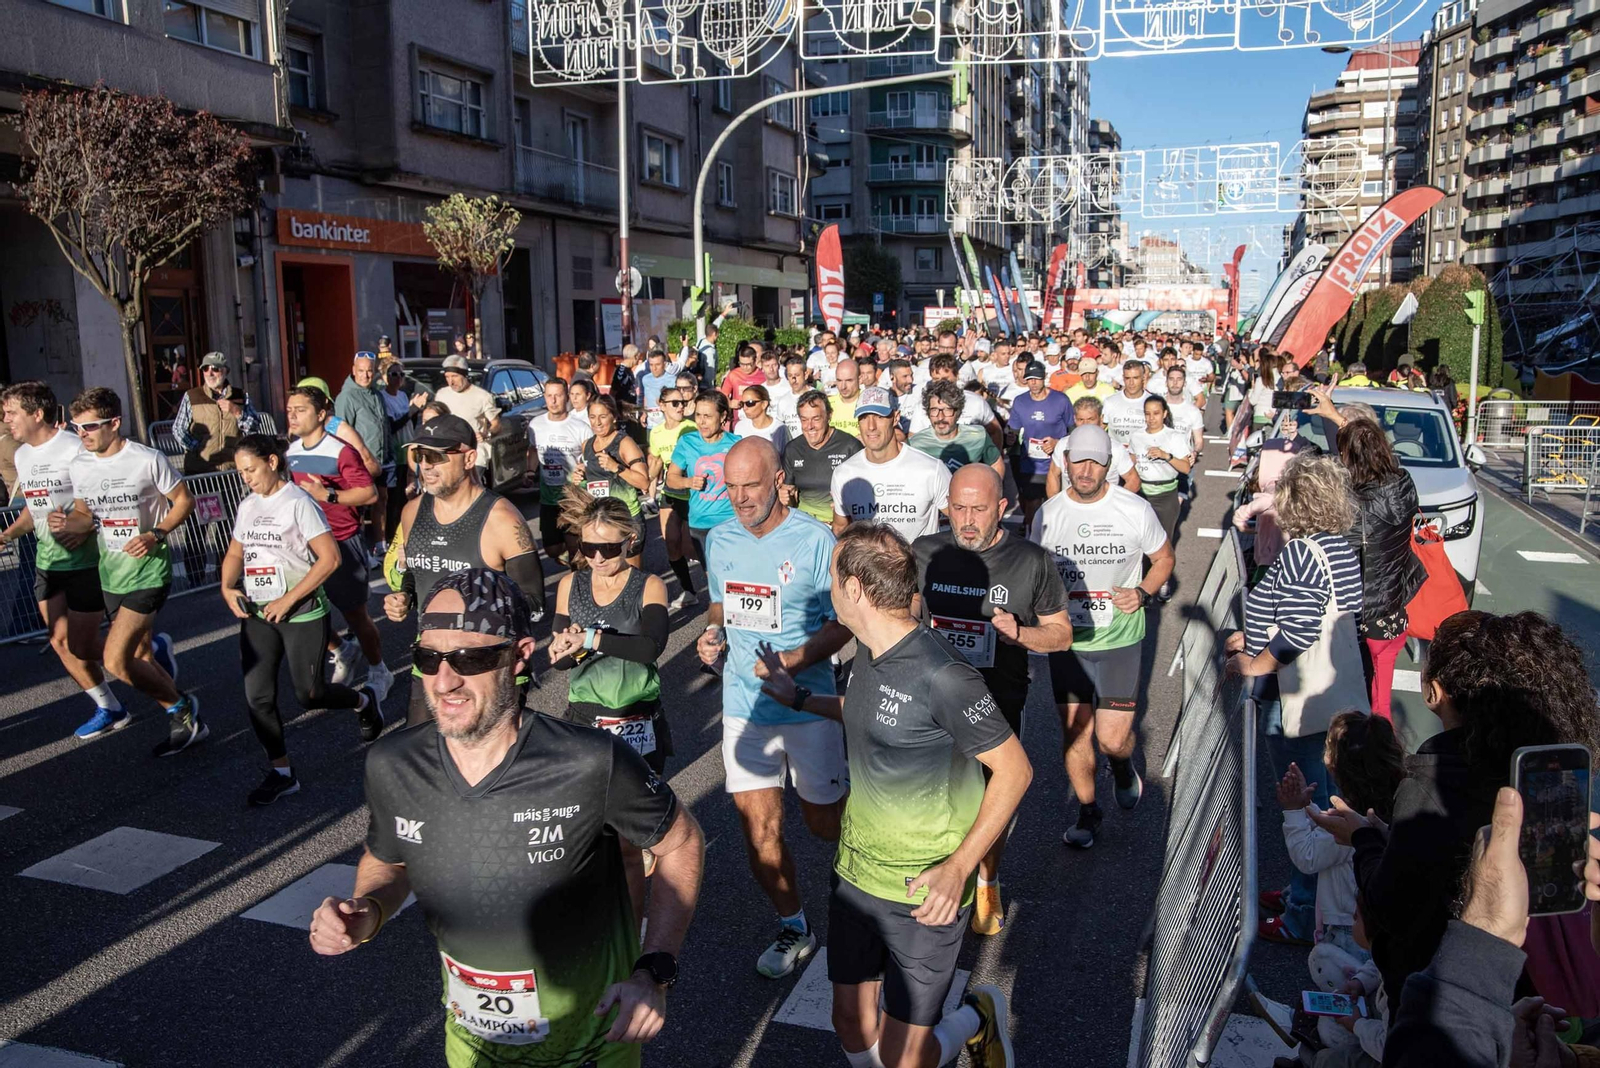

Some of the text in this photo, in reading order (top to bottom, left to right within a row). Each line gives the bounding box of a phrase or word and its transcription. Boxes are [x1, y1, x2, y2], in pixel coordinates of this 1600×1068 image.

[1330, 211, 1395, 287] FROIZ
[819, 264, 844, 338] ROIZ
[27, 478, 62, 489] Marcha
[33, 498, 48, 507] 484
[99, 492, 139, 506] Marcha
[852, 502, 917, 515] En Marcha
[113, 528, 133, 537] 447
[247, 531, 282, 541] Marcha
[1055, 543, 1126, 557] En Marcha
[406, 553, 432, 570] máis
[441, 558, 472, 572] auga
[254, 577, 273, 587] 554
[932, 582, 987, 597] PANELSHIP
[740, 597, 763, 611] 199
[1082, 601, 1107, 612] 465
[948, 633, 976, 648] 555
[879, 698, 899, 715] 2M
[963, 693, 993, 718] LA CASA
[876, 711, 897, 727] VIGO
[968, 713, 983, 725] DE
[616, 723, 645, 737] 222
[625, 735, 648, 744] MPÓN
[513, 808, 542, 823] máis
[551, 804, 581, 819] auga
[394, 816, 425, 840] DK
[528, 824, 564, 845] 2M
[528, 847, 565, 864] VIGO
[476, 993, 514, 1015] 20
